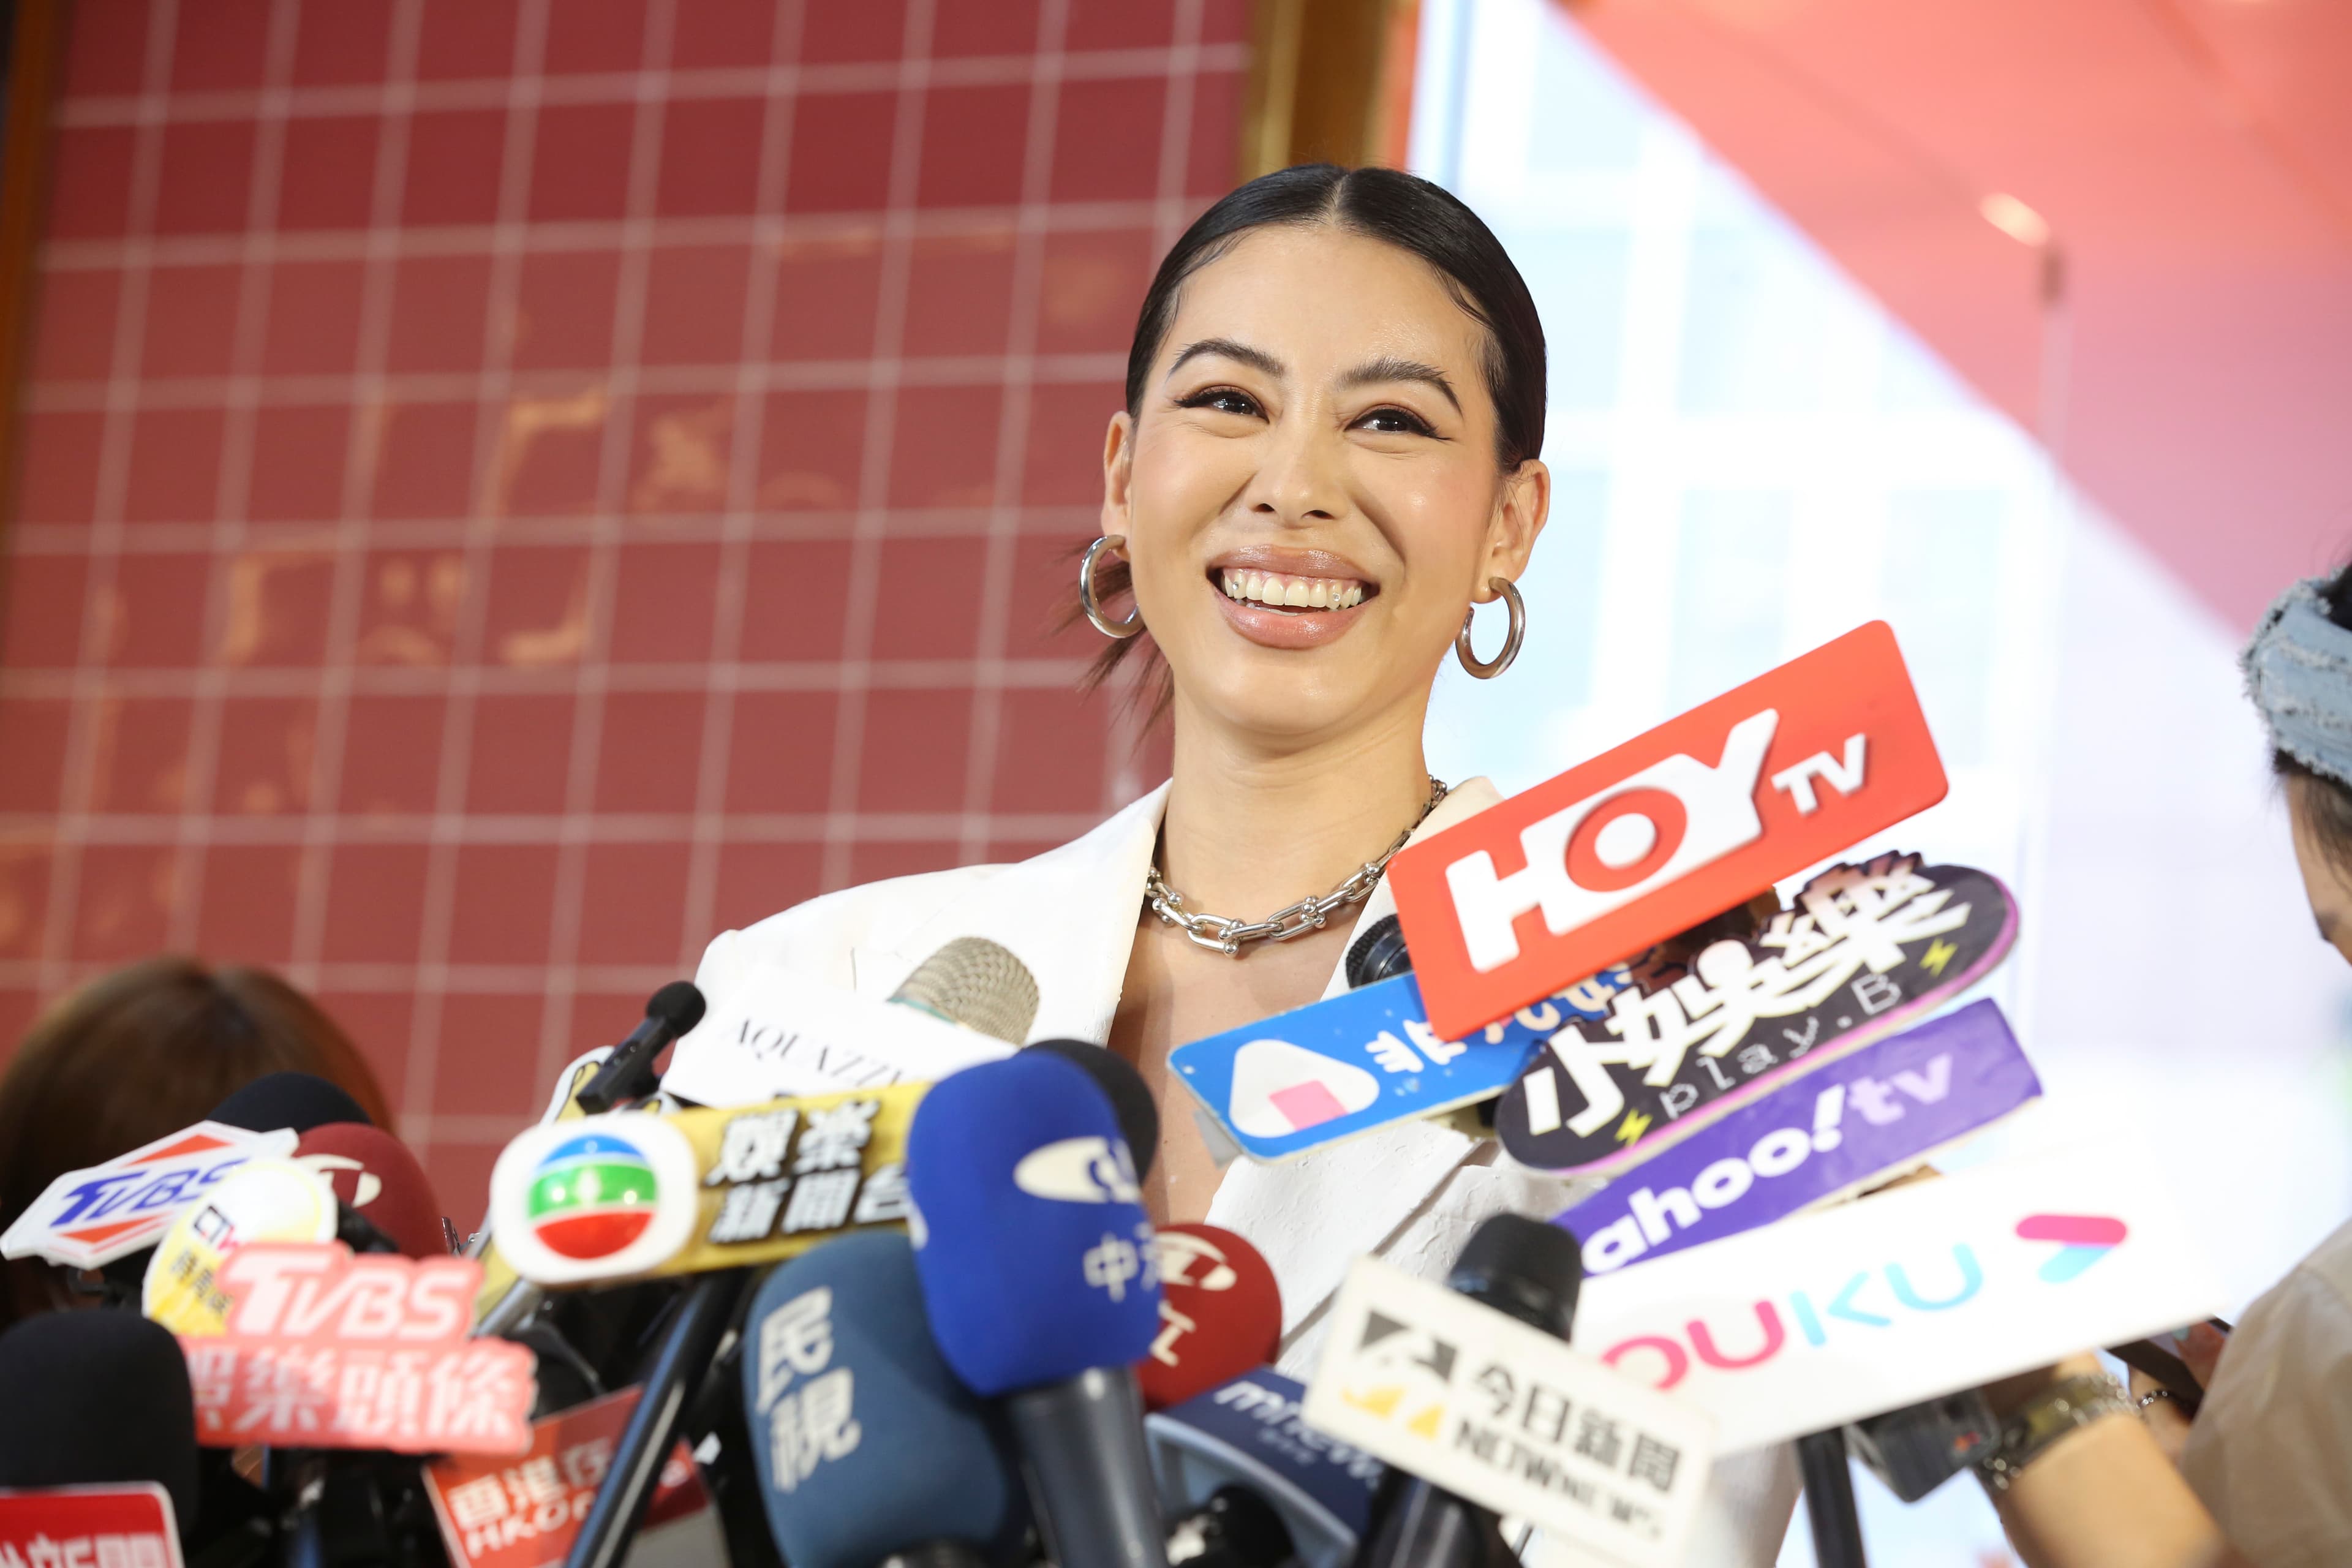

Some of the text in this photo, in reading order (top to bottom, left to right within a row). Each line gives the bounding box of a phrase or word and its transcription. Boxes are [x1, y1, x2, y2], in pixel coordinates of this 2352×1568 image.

[1444, 707, 1868, 974] HOY TV
[224, 1252, 472, 1340] TVBS
[757, 1285, 861, 1493] 民視
[1475, 1362, 1682, 1493] 今日新聞
